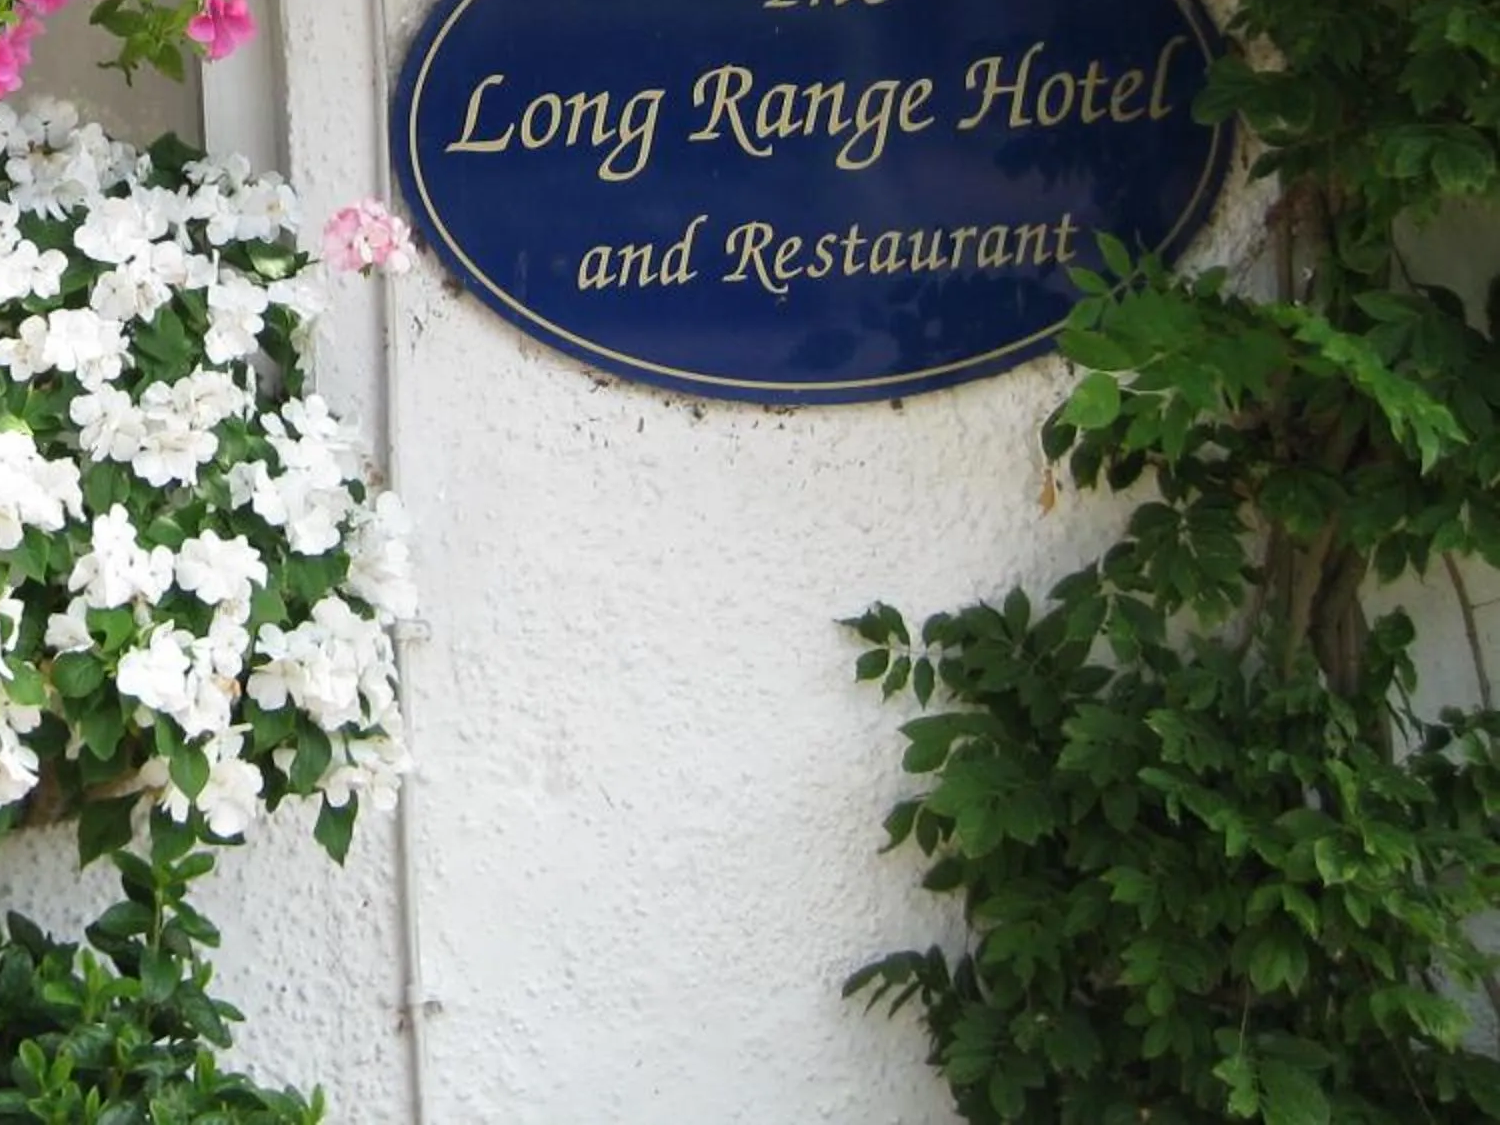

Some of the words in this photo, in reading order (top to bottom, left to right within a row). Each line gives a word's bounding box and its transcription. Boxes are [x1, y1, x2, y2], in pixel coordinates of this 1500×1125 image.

[444, 73, 666, 183] Long
[687, 63, 935, 171] Range
[957, 35, 1188, 131] Hotel
[576, 214, 709, 291] and
[721, 212, 1077, 295] Restaurant
